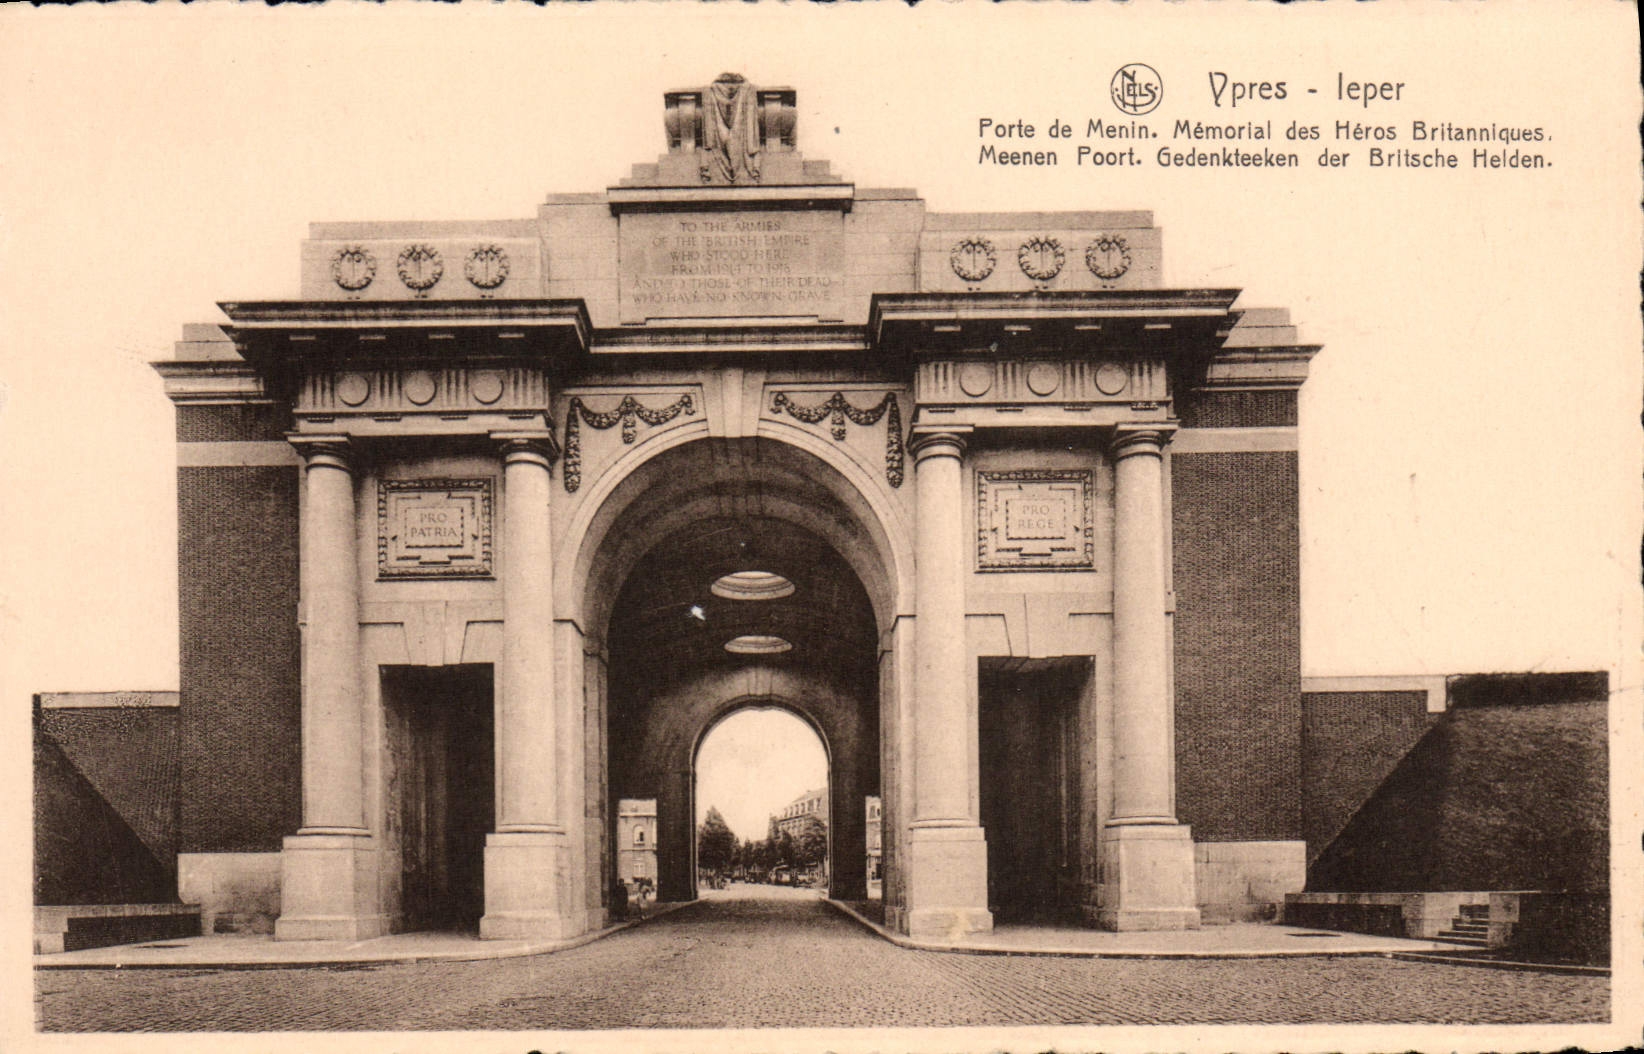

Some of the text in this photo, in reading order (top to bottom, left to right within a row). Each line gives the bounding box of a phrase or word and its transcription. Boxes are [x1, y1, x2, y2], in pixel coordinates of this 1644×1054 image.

[680, 221, 781, 232] TO THE ARMIES
[652, 234, 810, 248] OF THE BRITISH EMPIRE
[671, 249, 790, 262] WHO STOOD HERE
[671, 264, 711, 275] FROM
[747, 263, 763, 273] TO
[1022, 504, 1050, 515] PRO
[420, 512, 448, 523] PRO
[410, 526, 457, 538] PATRIA
